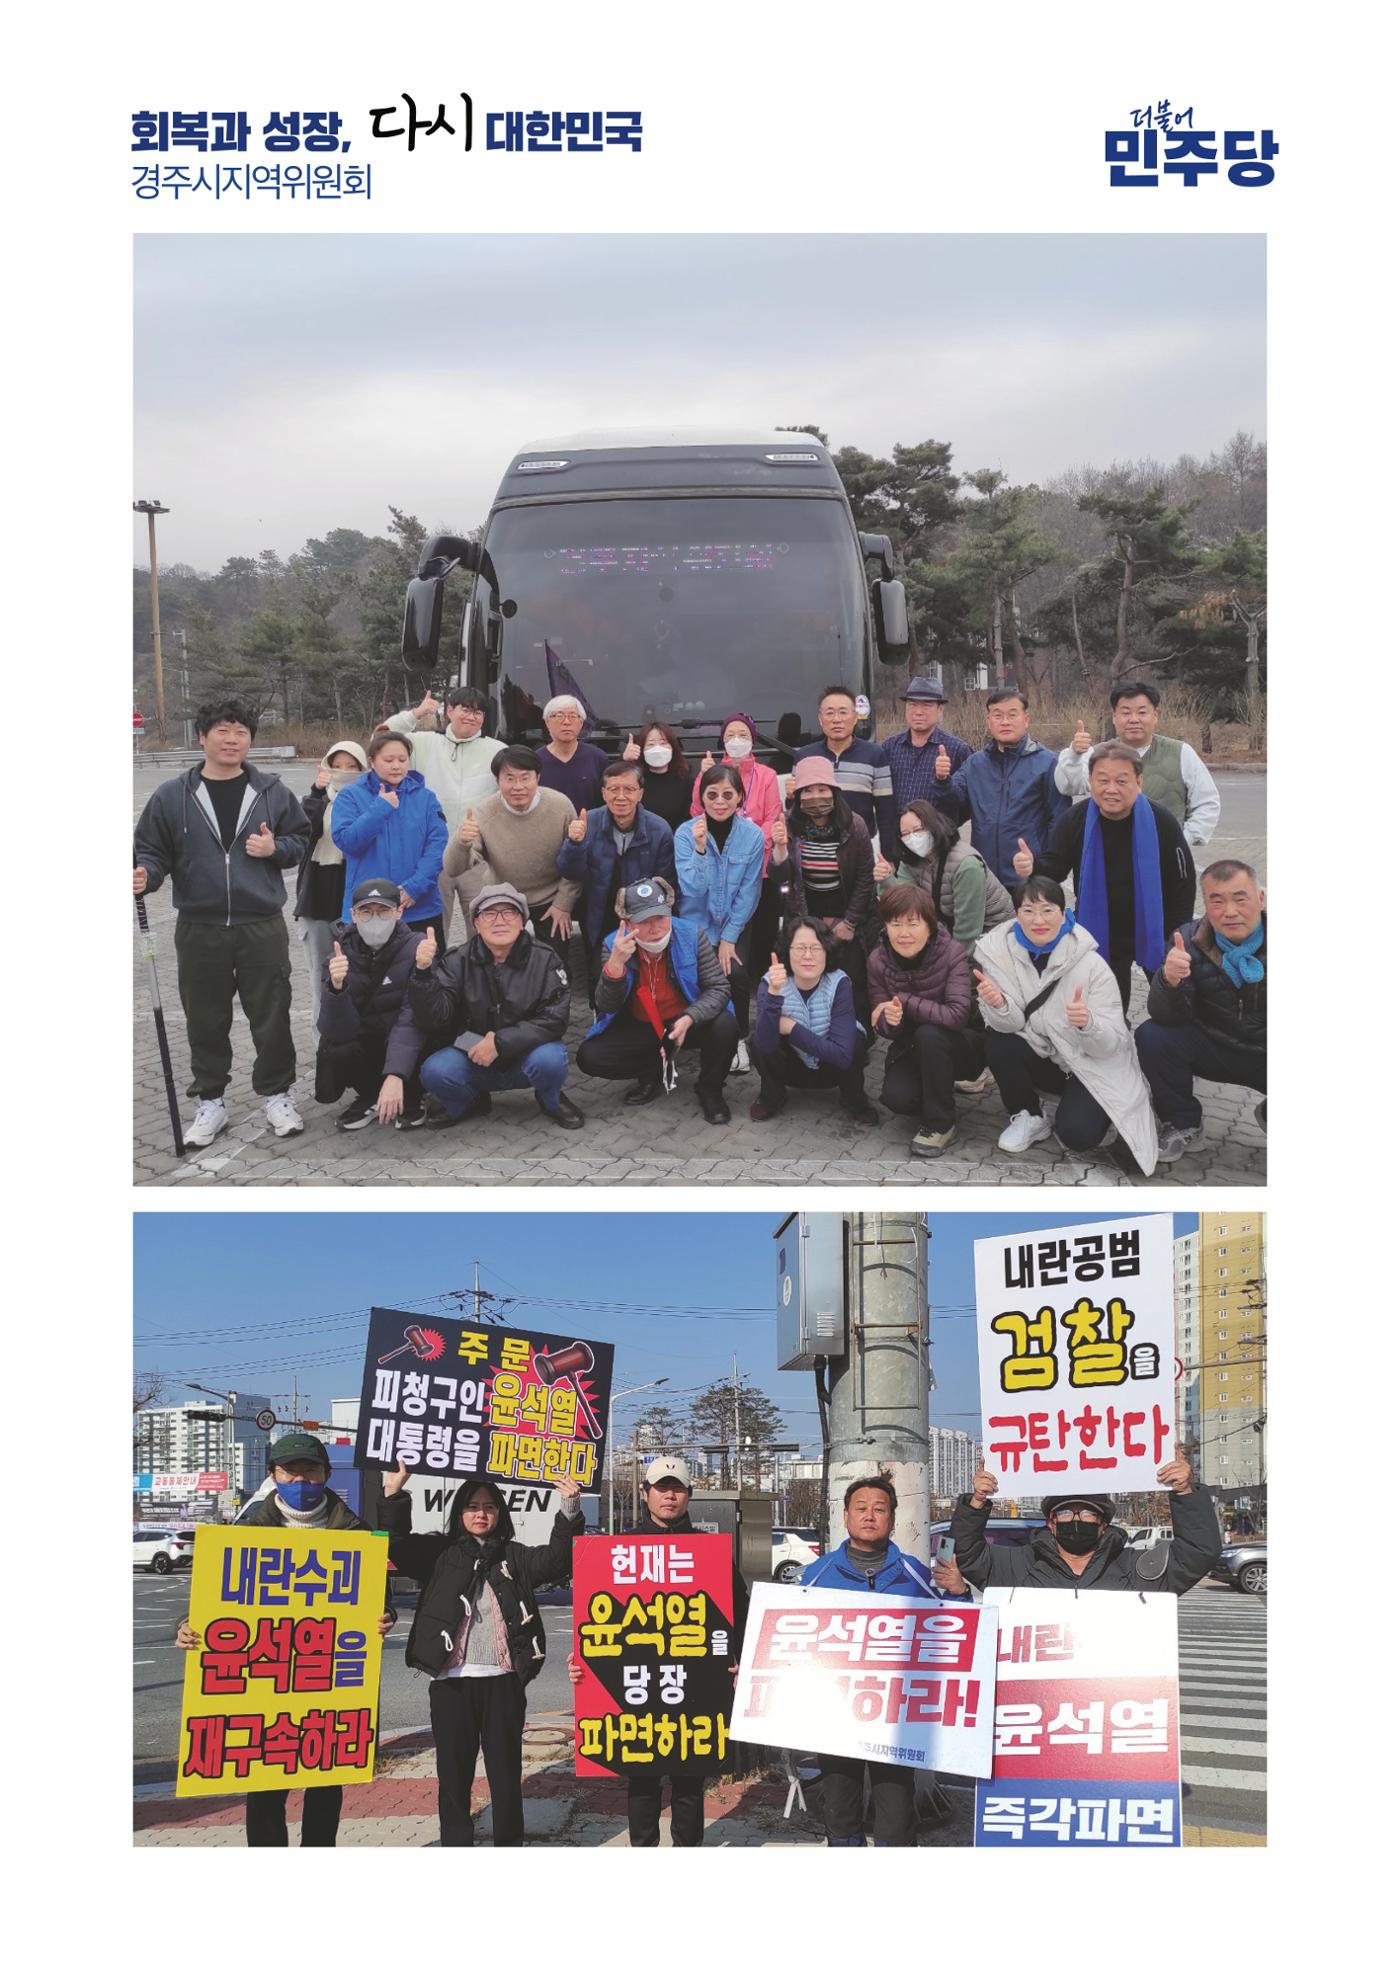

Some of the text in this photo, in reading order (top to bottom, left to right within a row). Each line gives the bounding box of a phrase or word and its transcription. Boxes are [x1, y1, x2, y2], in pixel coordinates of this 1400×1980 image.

[1004, 1230, 1140, 1288] 내란공범
[992, 1297, 1159, 1393] 검찰을
[261, 1415, 272, 1426] 50
[371, 1369, 577, 1436] 피청구인 윤석열
[366, 1418, 598, 1487] 대통령을 파면한다
[989, 1405, 1169, 1473] 규탄한다
[221, 1547, 361, 1606] 내란수괴
[611, 1545, 694, 1584] 헌재는
[579, 1592, 728, 1657] 윤석열을
[769, 1615, 967, 1663] 윤석열을
[200, 1617, 367, 1694] 윤석열을
[183, 1708, 373, 1778] 재구속하라
[579, 1712, 729, 1762] 파면하라
[994, 1700, 1168, 1755] 윤석열
[983, 1797, 1173, 1843] 즉각파면
